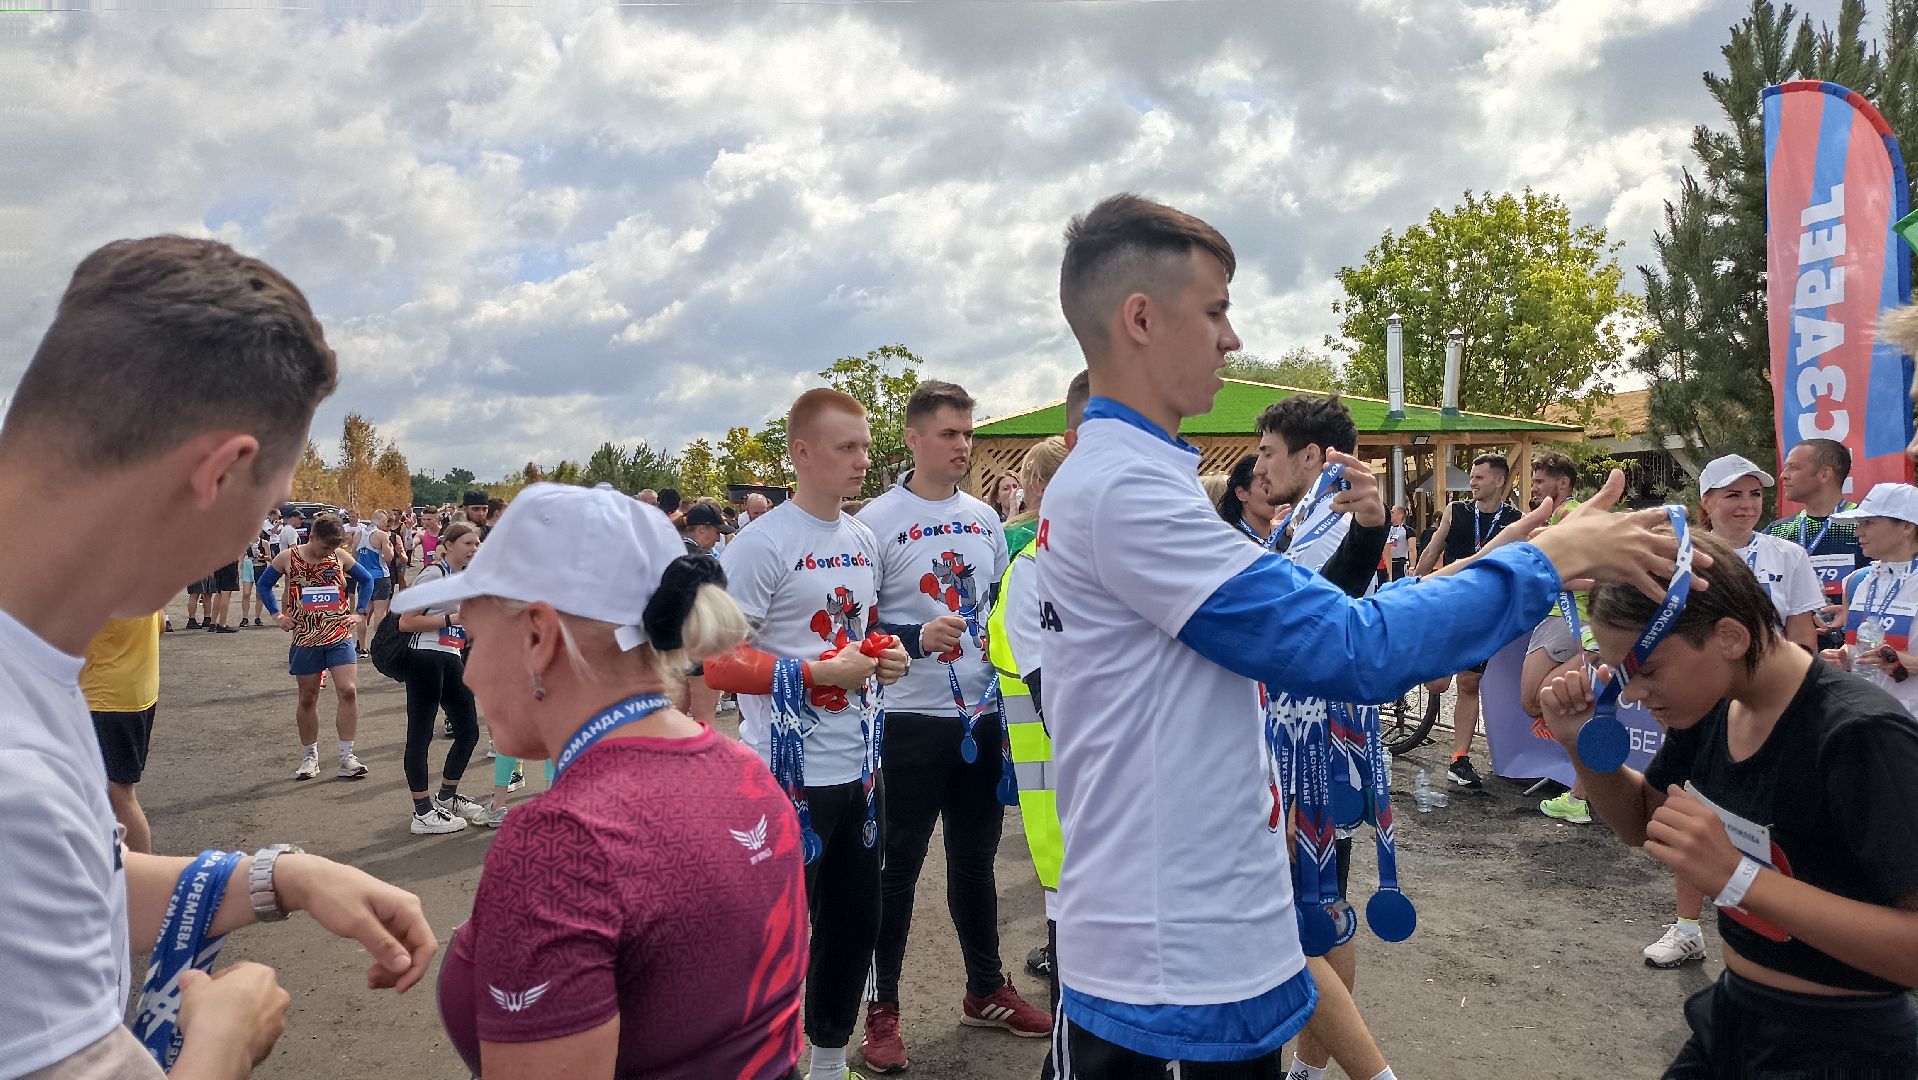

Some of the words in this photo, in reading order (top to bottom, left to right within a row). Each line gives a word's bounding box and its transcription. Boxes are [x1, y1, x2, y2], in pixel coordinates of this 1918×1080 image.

[897, 521, 993, 545] #боксЗабег
[312, 594, 331, 603] 520
[174, 871, 210, 951] КРЕМЛЕВА
